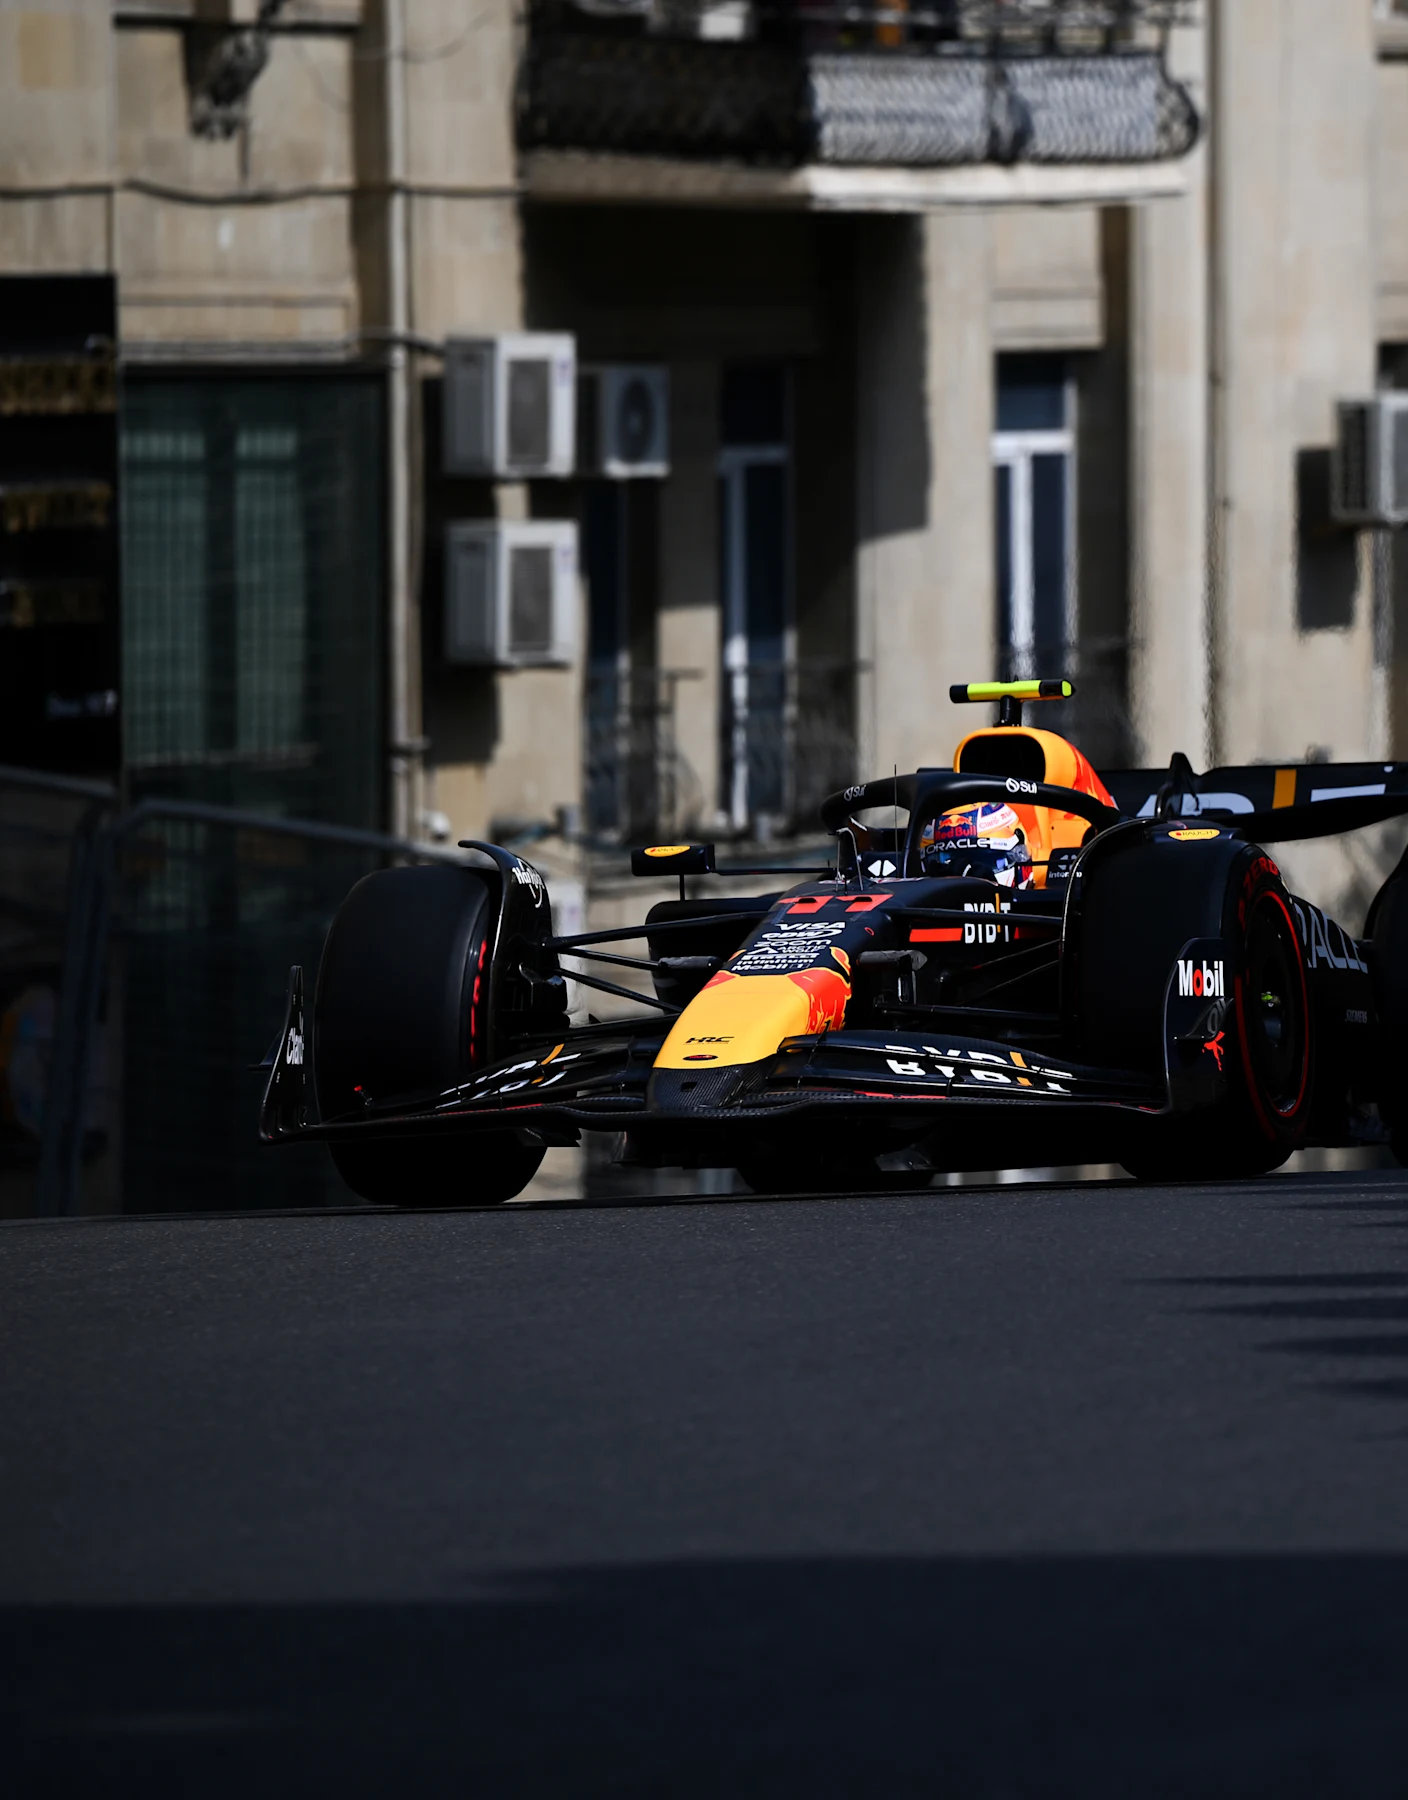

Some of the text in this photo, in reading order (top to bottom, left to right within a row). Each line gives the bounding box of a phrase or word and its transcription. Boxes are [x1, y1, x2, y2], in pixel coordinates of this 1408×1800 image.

[955, 825, 977, 838] Bull
[926, 838, 990, 855] ORACLE
[774, 921, 846, 931] VISA
[753, 939, 833, 949] zoom
[731, 963, 789, 972] Mobil
[1177, 959, 1225, 998] Mobil
